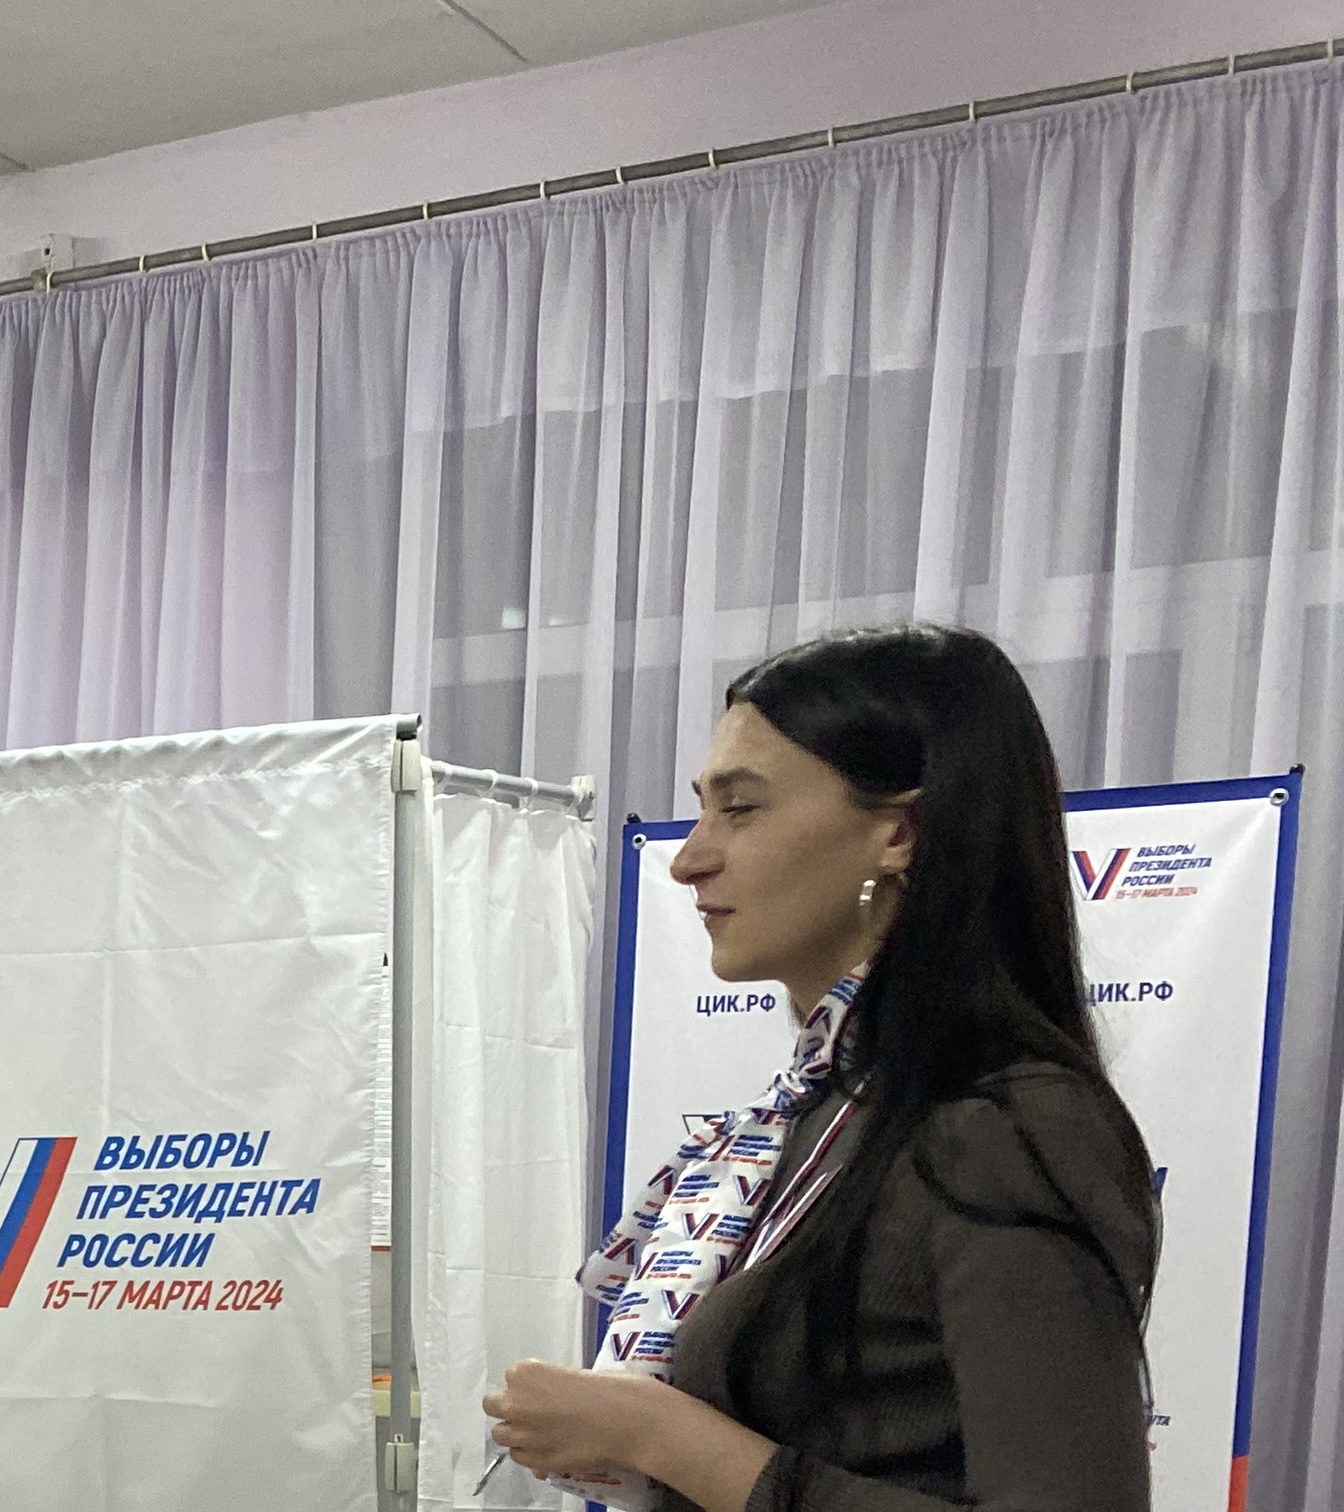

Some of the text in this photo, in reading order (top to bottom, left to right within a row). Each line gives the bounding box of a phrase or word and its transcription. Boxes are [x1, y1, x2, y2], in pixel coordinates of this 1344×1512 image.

[1129, 857, 1212, 872] ПРЕЗИДЕНТА
[1137, 844, 1196, 858] ВЫБОРЫ
[1122, 874, 1175, 887] РОССИИ
[696, 993, 776, 1017] ЦИК.РФ
[93, 1131, 271, 1171] ВЫБОРЫ
[76, 1178, 321, 1224] ПРЕЗИДЕНТА
[57, 1231, 216, 1269] РОССИИ
[117, 1279, 212, 1311] МАРТА
[215, 1279, 284, 1312] 2024
